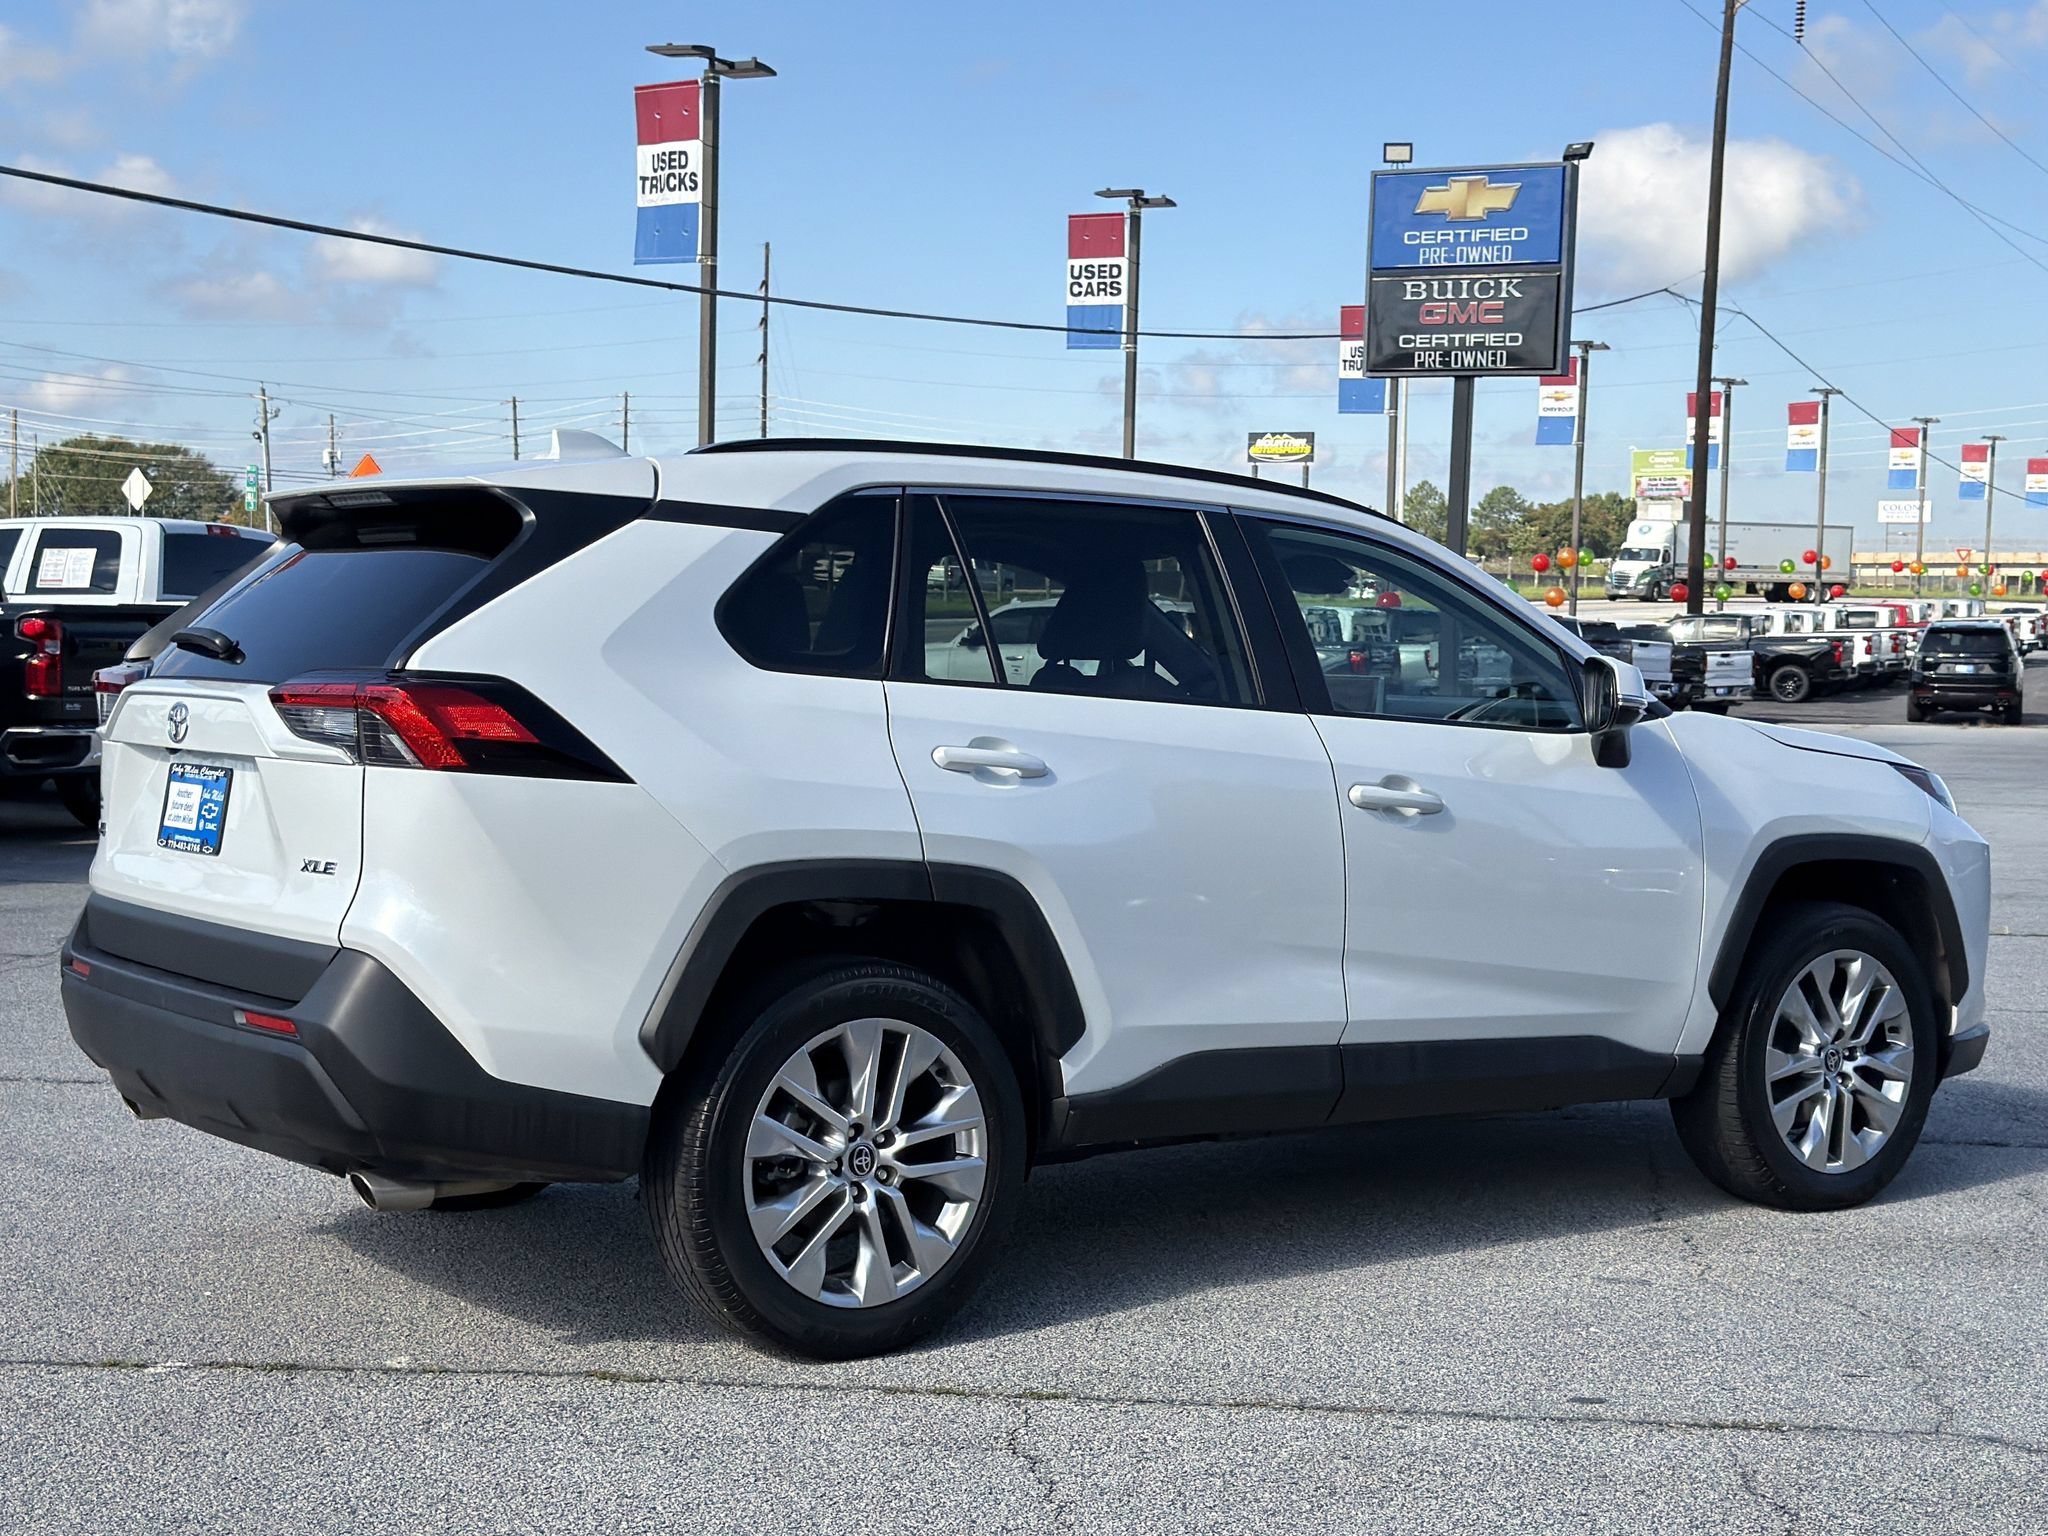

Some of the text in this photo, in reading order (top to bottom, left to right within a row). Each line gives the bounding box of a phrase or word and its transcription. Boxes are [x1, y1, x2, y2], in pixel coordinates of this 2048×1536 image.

[651, 150, 689, 173] USED
[639, 171, 698, 195] TRUCKS
[1403, 227, 1529, 245] CERTIFIED
[1419, 244, 1512, 264] PRE-OWNED
[1070, 263, 1122, 280] USED
[1069, 280, 1122, 297] CARS
[1402, 278, 1523, 300] BUICK
[1419, 300, 1504, 325] GMC
[1398, 332, 1523, 348] CERTIFIED
[1350, 345, 1364, 358] US
[1414, 349, 1507, 368] PRE-OWNED
[1883, 503, 1923, 512] COLON
[300, 858, 338, 876] XLE
